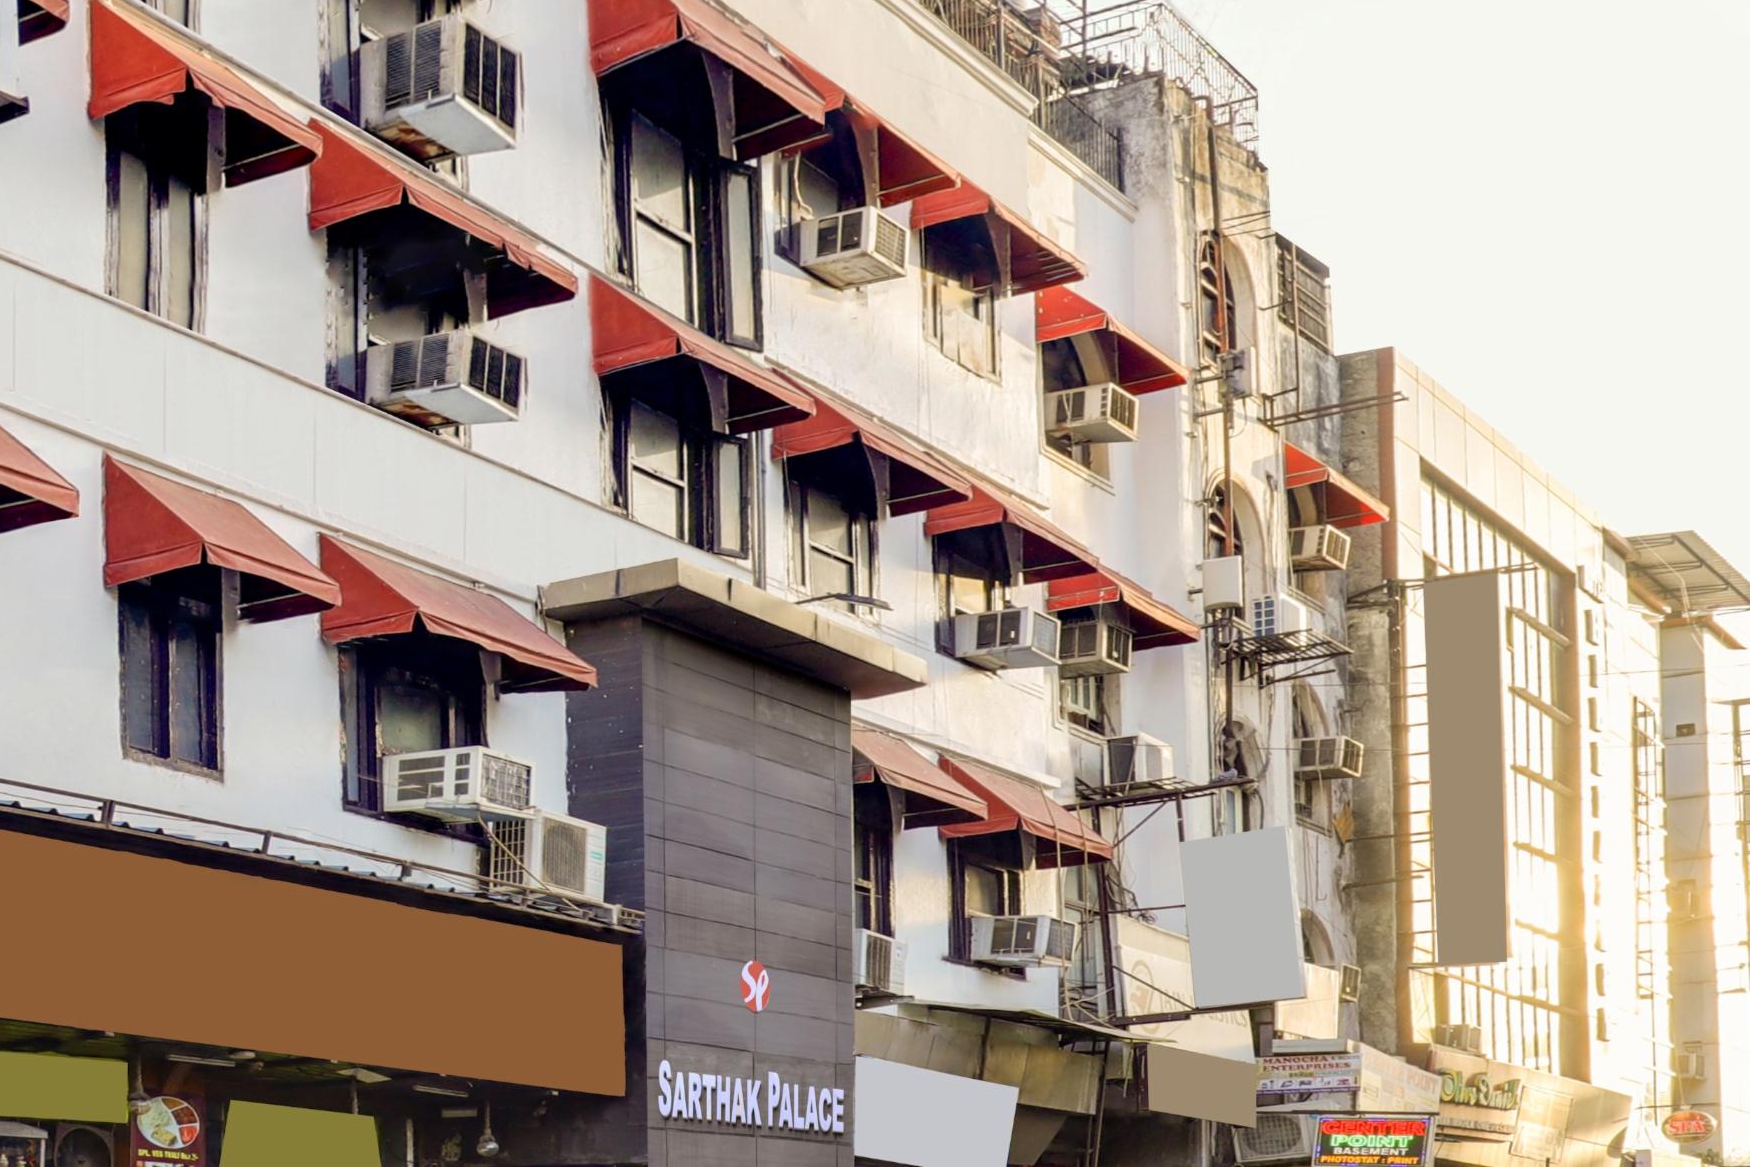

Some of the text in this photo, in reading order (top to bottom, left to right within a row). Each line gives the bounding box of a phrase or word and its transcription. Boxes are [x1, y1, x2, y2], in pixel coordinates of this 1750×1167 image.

[1263, 1056, 1329, 1064] MANOCHA
[1263, 1061, 1352, 1072] ENTERPRISES
[658, 1060, 845, 1133] SARTHAK PALACE
[1320, 1120, 1426, 1136] CENTER
[1665, 1120, 1705, 1134] SPA
[1330, 1134, 1414, 1148] POINT
[1333, 1147, 1410, 1156] BASEMENT
[1320, 1155, 1380, 1164] PHOTOSTAT
[1387, 1156, 1419, 1165] PRINT
